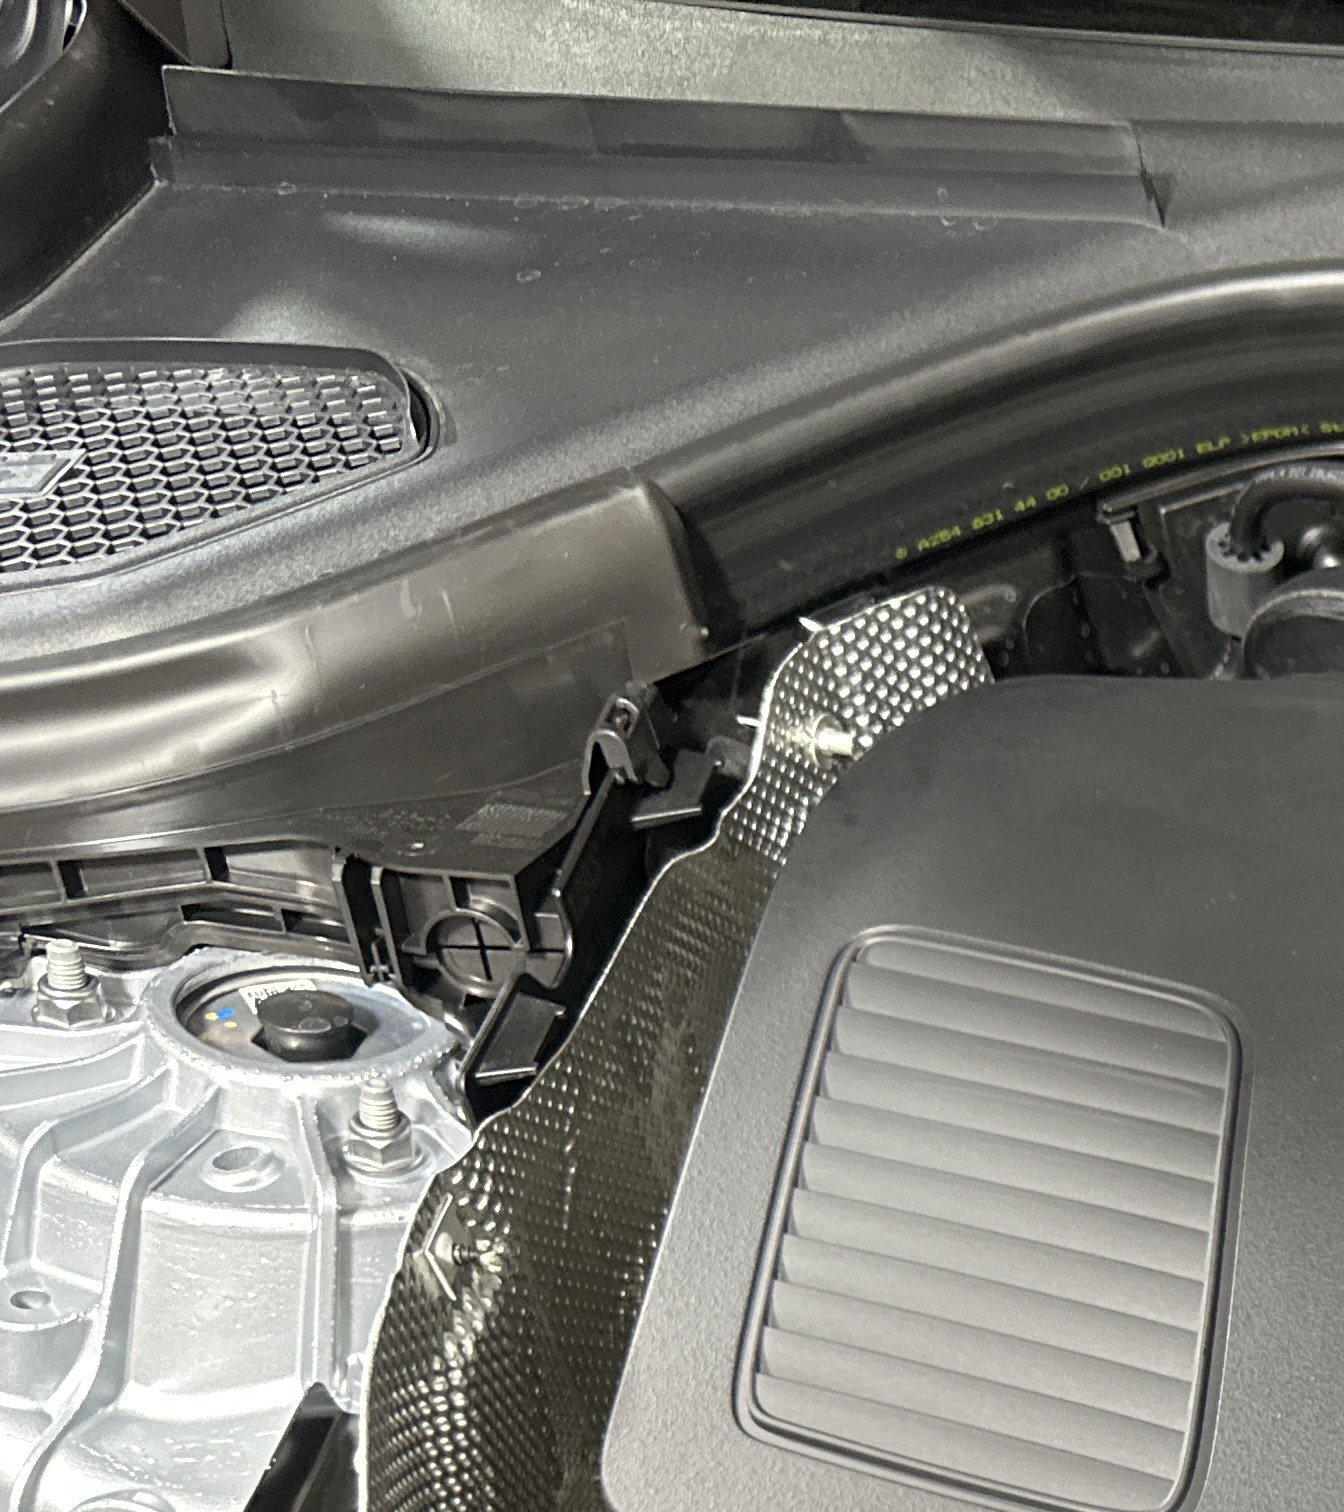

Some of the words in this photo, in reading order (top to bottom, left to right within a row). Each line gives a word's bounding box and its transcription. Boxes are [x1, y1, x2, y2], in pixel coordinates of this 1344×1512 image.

[1046, 483, 1070, 501] 00
[1099, 463, 1131, 482] 001
[1142, 449, 1184, 469] 0001
